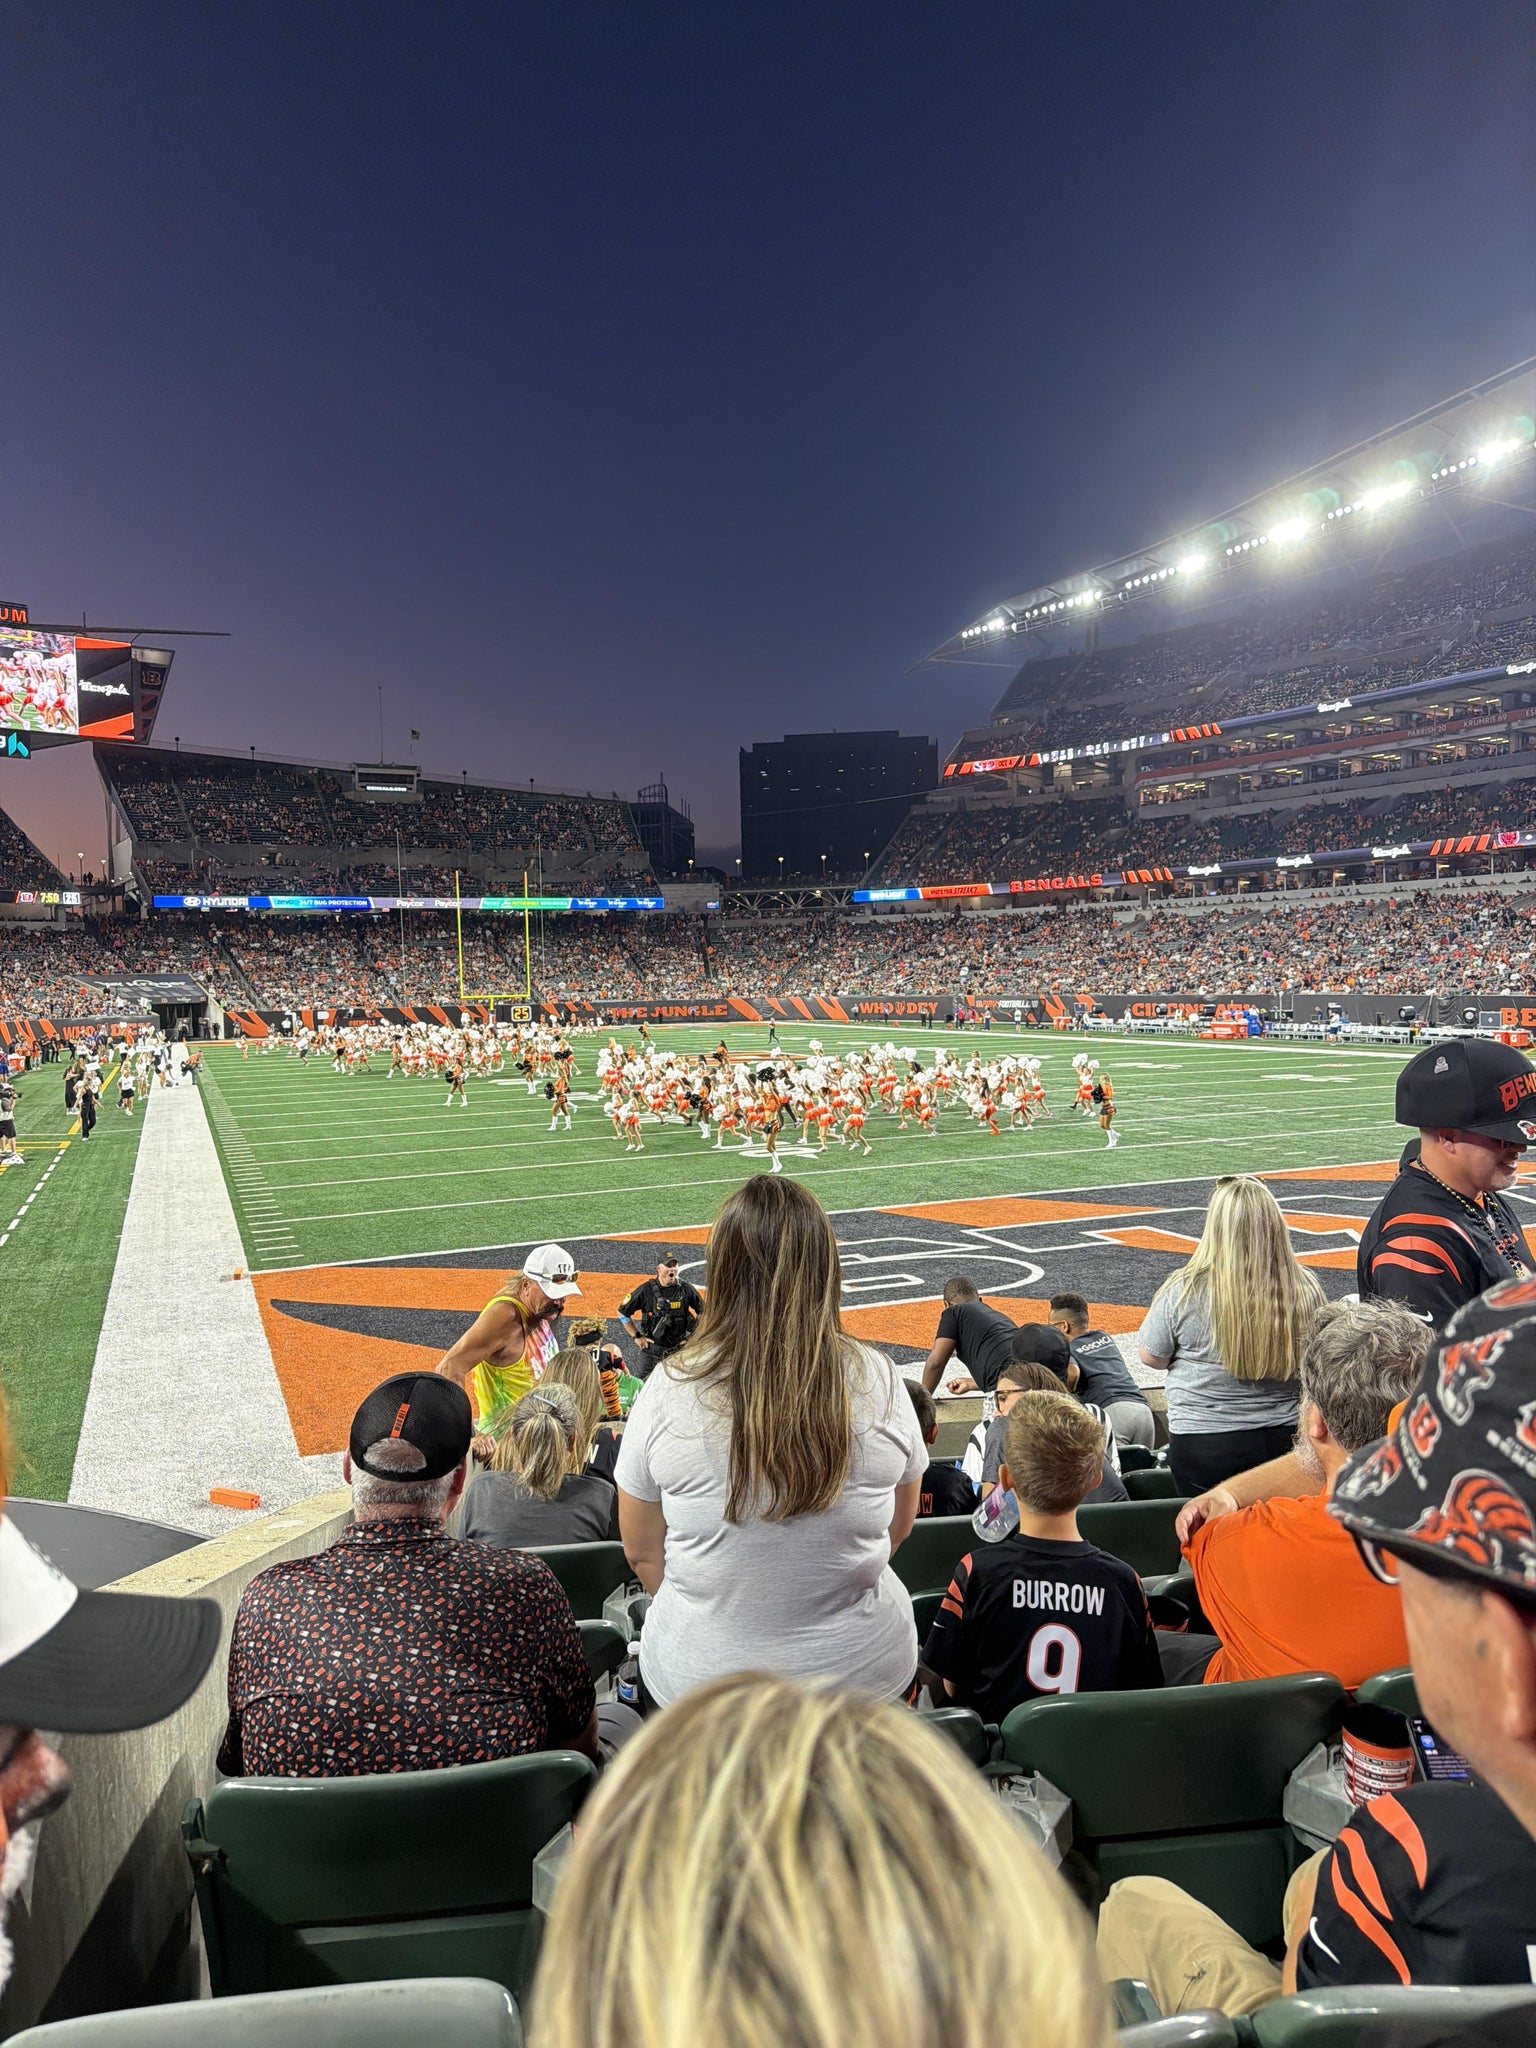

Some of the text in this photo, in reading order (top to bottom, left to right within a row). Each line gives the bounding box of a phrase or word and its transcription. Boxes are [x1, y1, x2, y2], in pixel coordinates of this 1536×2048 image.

[1463, 713, 1508, 728] KRUMRIE 69
[1407, 724, 1447, 738] PARRISH 20
[1010, 874, 1103, 893] BENGALS
[203, 897, 249, 906] HYUNDAI
[513, 1010, 528, 1021] 25
[1012, 1579, 1105, 1616] BURROW
[1025, 1622, 1083, 1695] 9
